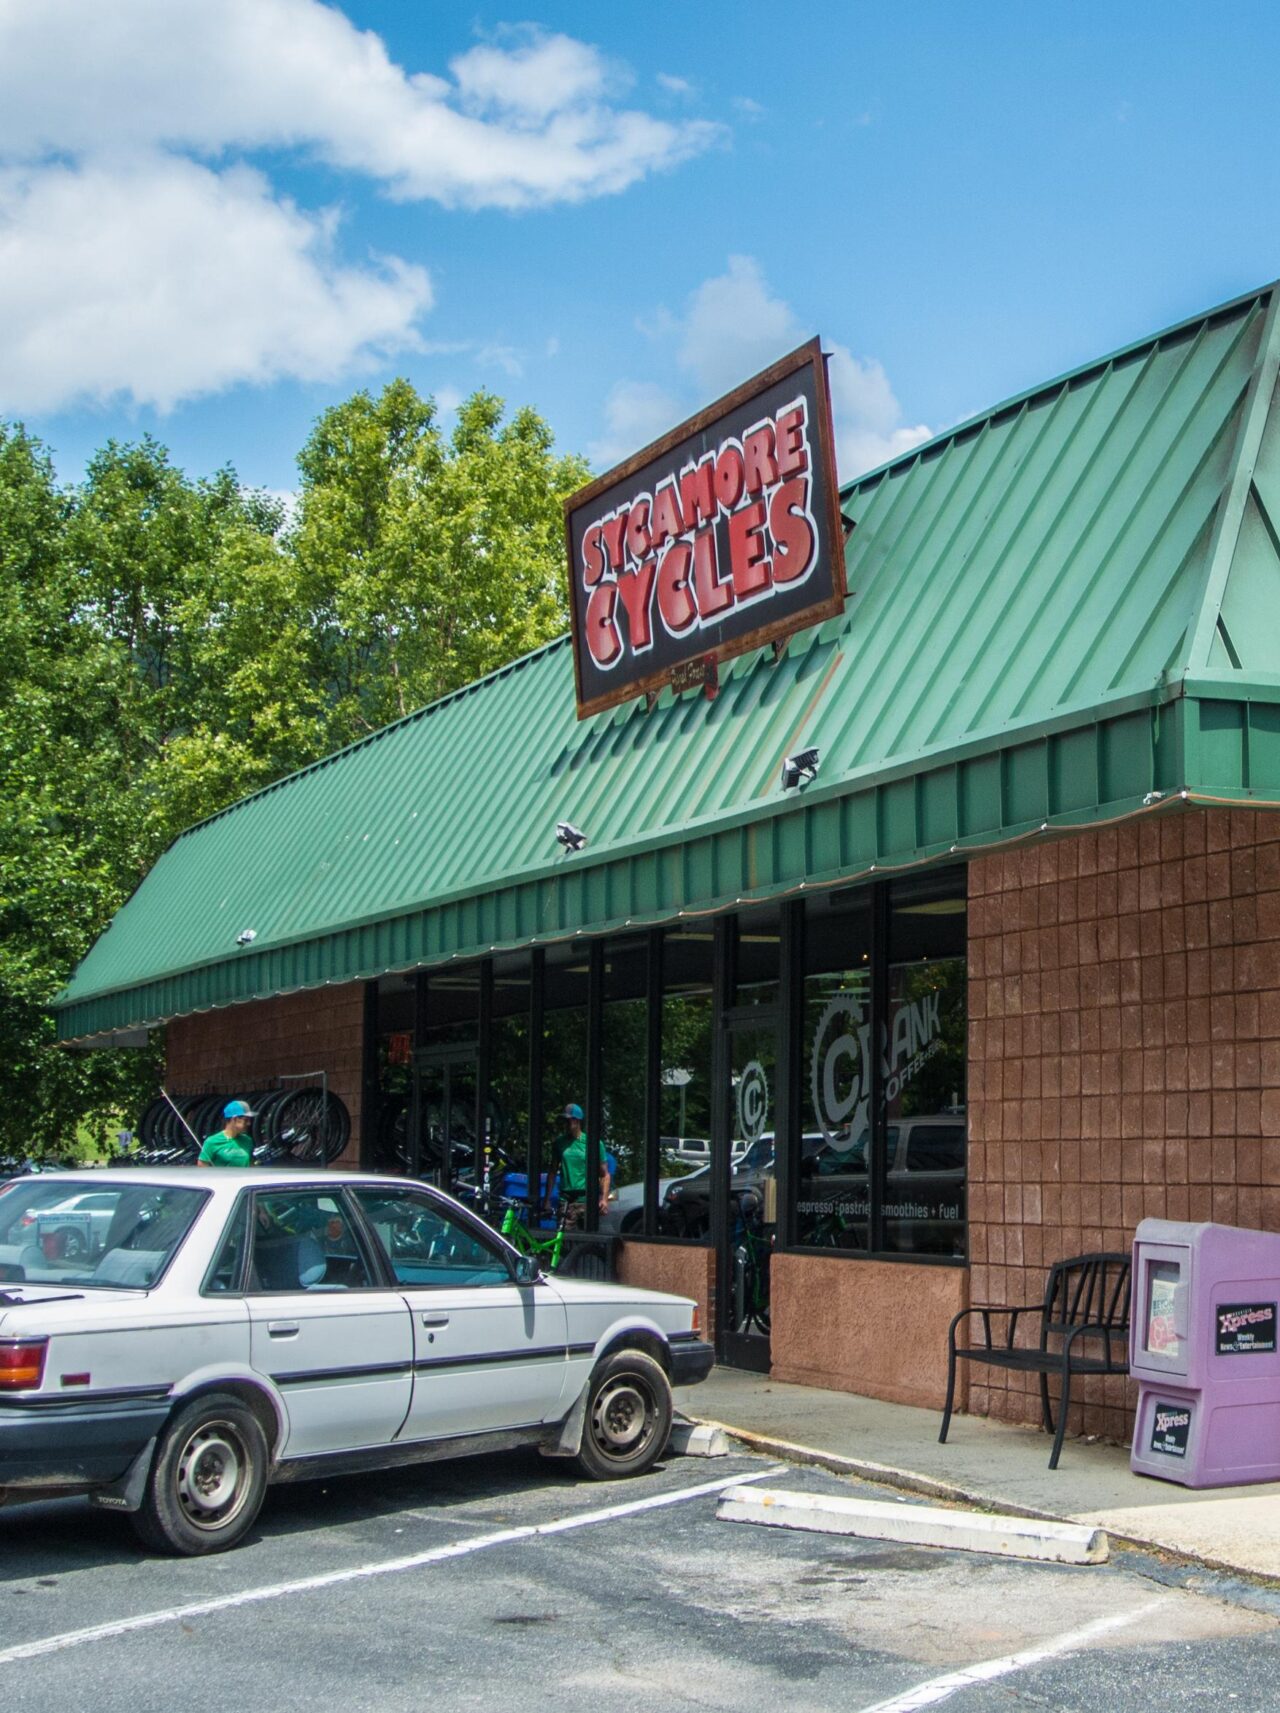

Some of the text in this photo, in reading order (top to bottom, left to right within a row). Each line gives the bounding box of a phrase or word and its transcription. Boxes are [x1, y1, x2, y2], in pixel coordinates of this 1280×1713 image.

[583, 396, 809, 591] SYCAMORE
[585, 477, 819, 671] CYCLES
[797, 1201, 834, 1215] espresso
[839, 1201, 871, 1217] pastrie
[881, 1202, 928, 1218] smoothies
[939, 1203, 959, 1219] fuel
[1219, 1308, 1273, 1334] Xpress
[1156, 1413, 1188, 1432] Xpress
[97, 1496, 128, 1506] TOYOTA
